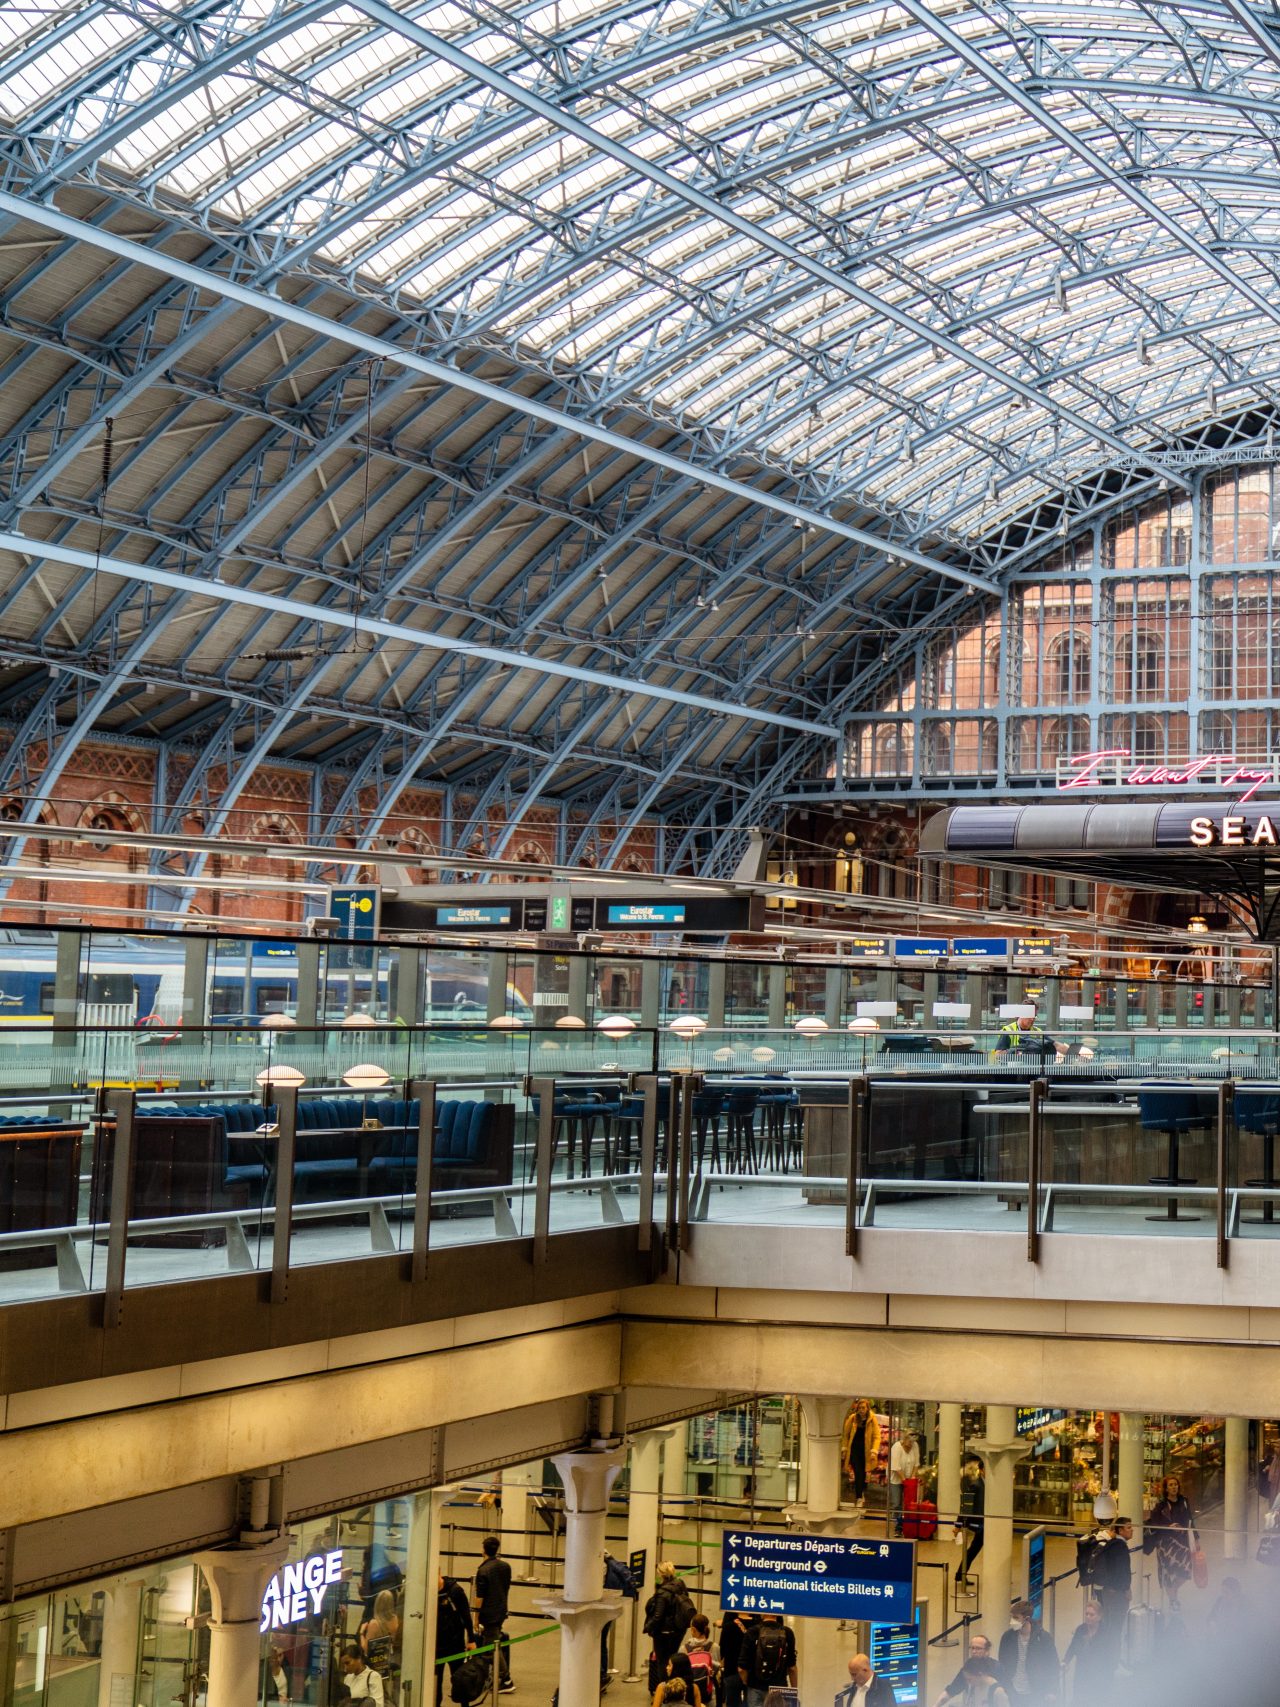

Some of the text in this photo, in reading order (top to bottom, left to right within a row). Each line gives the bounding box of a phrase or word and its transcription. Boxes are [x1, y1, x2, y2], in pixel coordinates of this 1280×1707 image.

[1058, 749, 1130, 790] I
[1127, 754, 1236, 784] want
[1223, 766, 1274, 802] my
[457, 908, 480, 917] Eurostar
[630, 906, 654, 915] Eurostar
[745, 1536, 802, 1552] Departures
[804, 1540, 845, 1555] Départs
[744, 1556, 811, 1572] Underground
[743, 1576, 881, 1597] International tickets Billets
